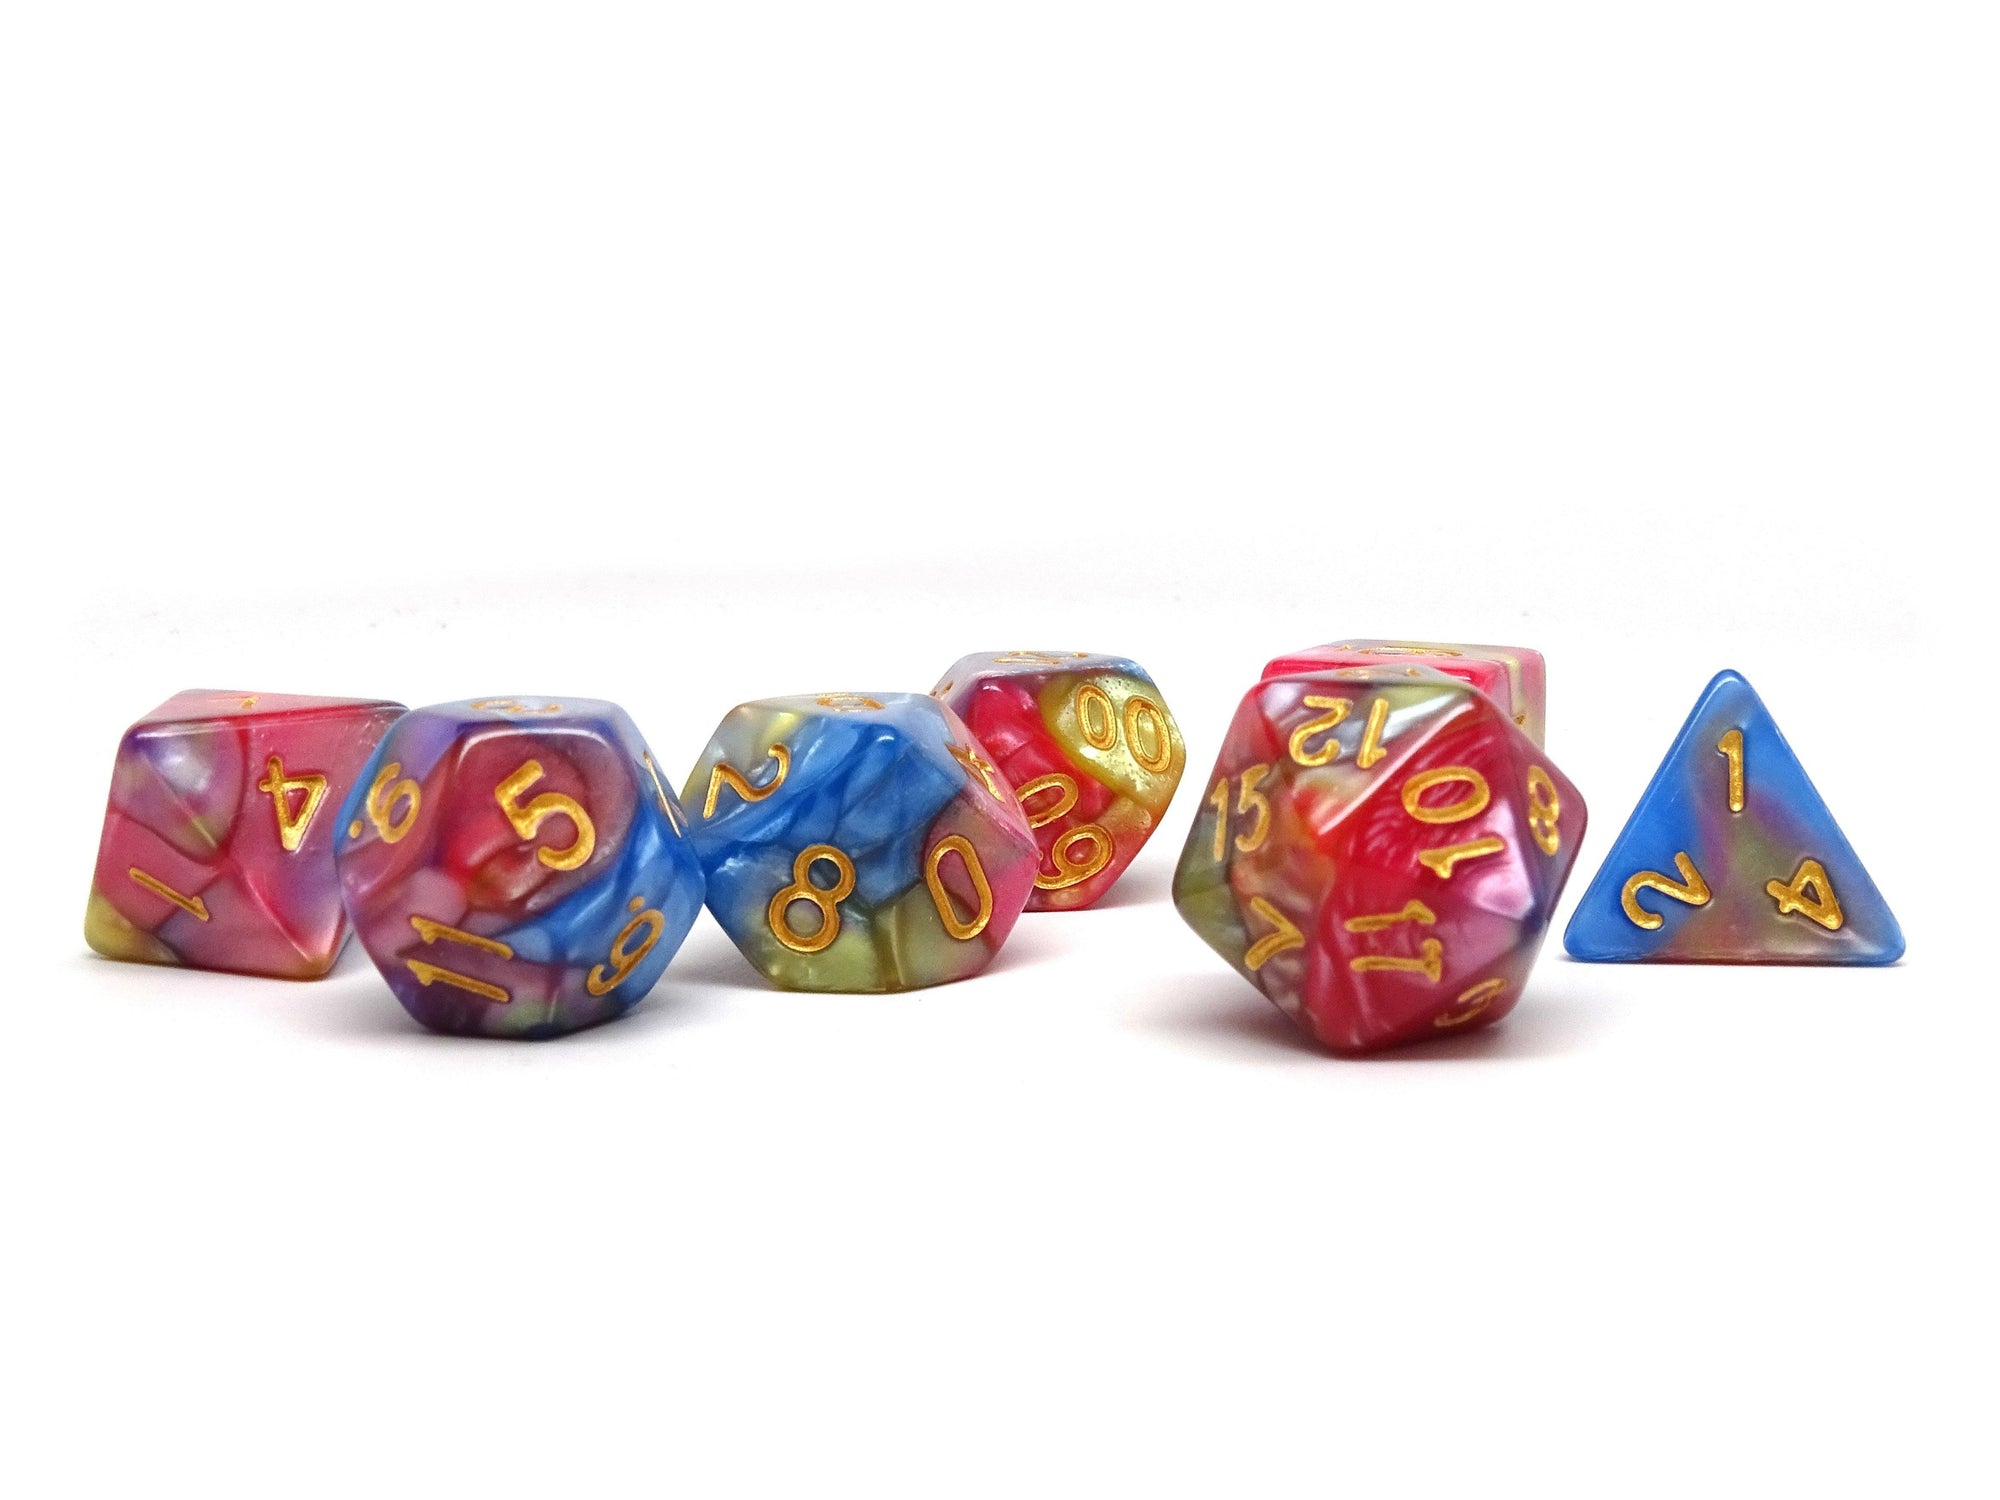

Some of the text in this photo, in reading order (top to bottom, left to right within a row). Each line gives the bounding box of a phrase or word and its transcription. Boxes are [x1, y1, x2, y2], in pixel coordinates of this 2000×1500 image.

[1076, 684, 1172, 773] 00
[1288, 695, 1389, 769] 12
[1717, 729, 1744, 812] 1
[258, 756, 327, 851] 4
[494, 759, 596, 871] 5
[703, 744, 791, 819] 2
[1210, 764, 1271, 861] 15
[1401, 765, 1505, 878] 10
[1526, 765, 1560, 856] 8
[129, 866, 210, 923] 1
[768, 844, 856, 953] 8
[926, 834, 993, 941] 0
[1621, 852, 1711, 930] 2
[1766, 859, 1844, 931] 4
[407, 915, 514, 1003] 11
[1243, 897, 1305, 971] 7
